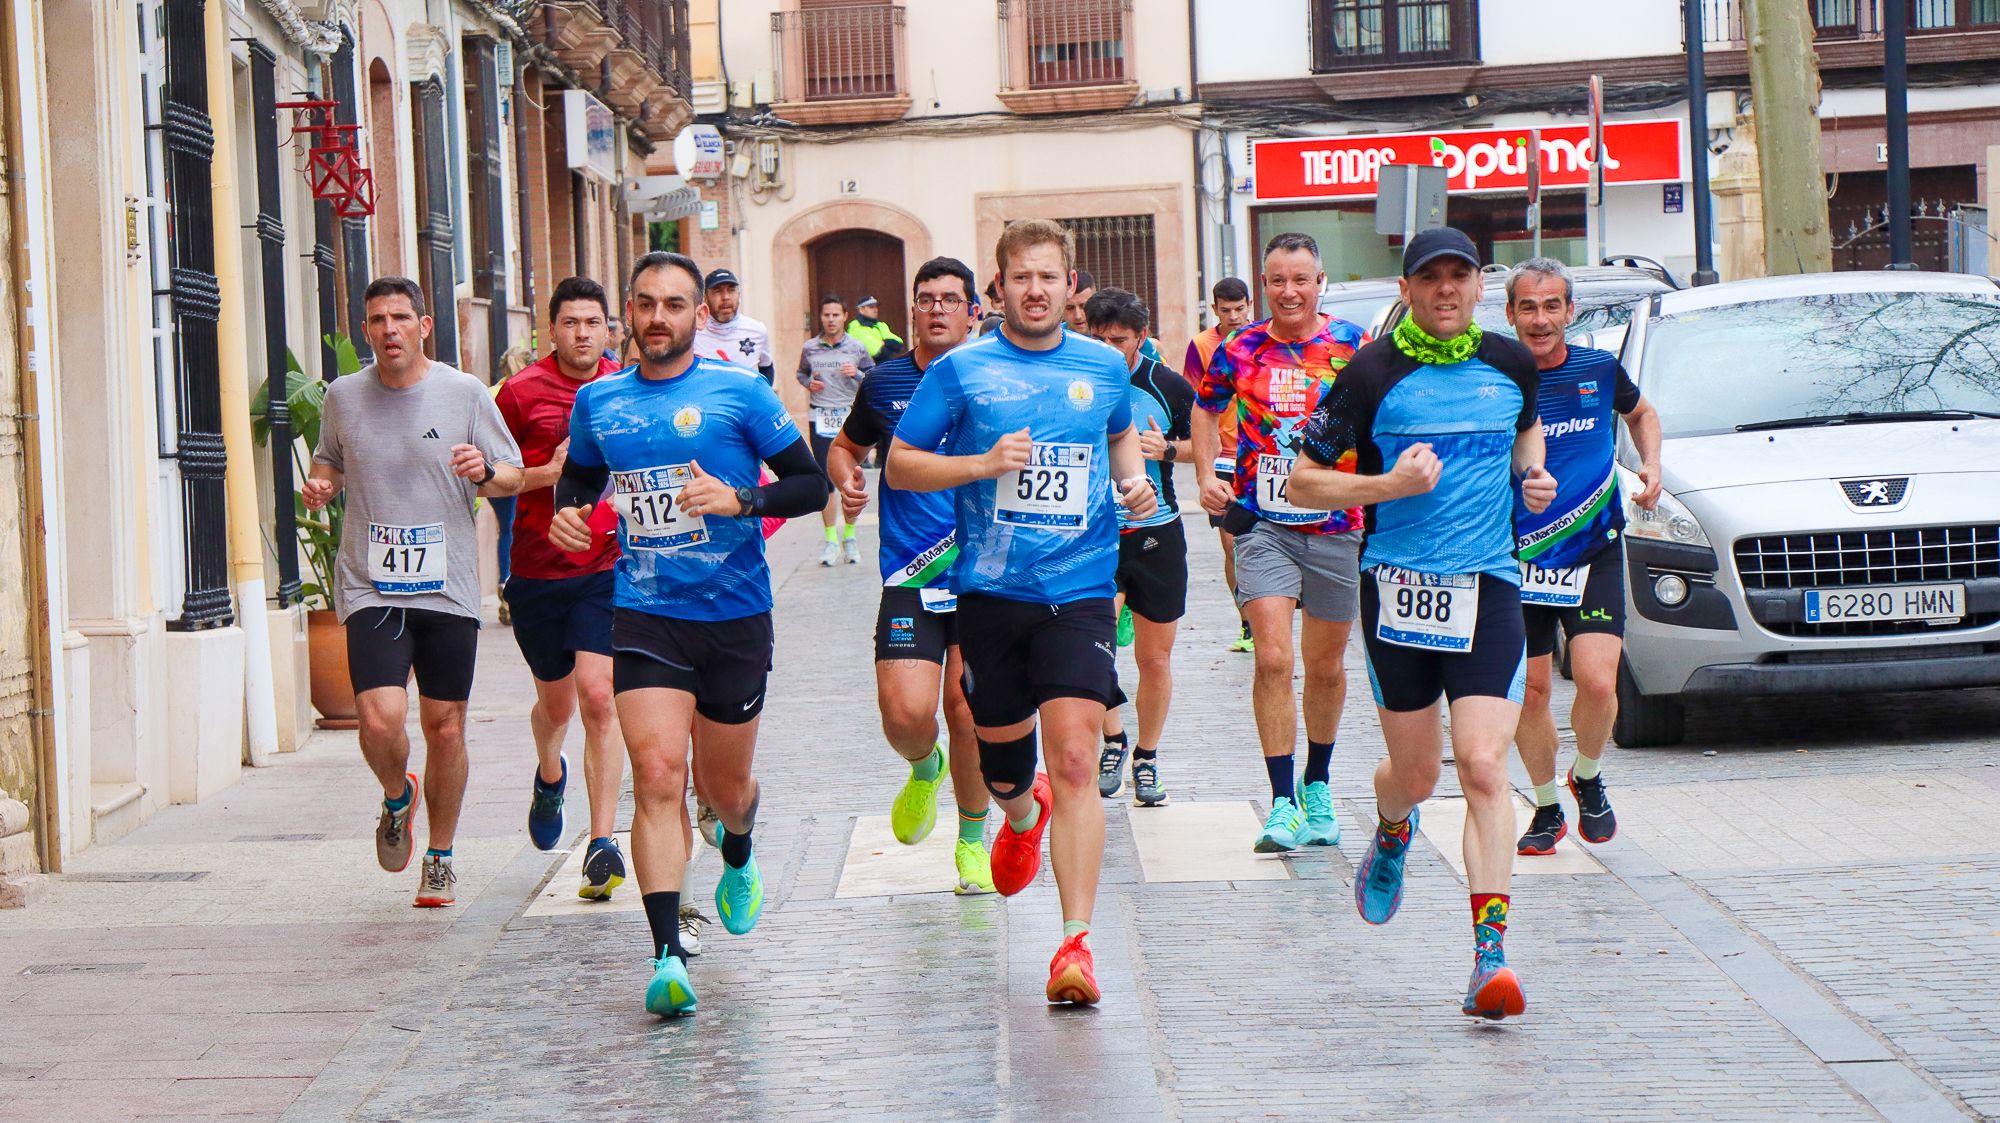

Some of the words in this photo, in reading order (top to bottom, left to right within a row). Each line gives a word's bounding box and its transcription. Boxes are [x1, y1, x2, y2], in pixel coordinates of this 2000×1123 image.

[1430, 136, 1619, 189] optima
[1542, 417, 1596, 438] erplus
[1017, 469, 1069, 502] 523
[1266, 472, 1289, 503] 14
[631, 493, 677, 526] 512
[1531, 513, 1573, 544] Maratón
[1570, 488, 1605, 520] Lucena
[378, 526, 402, 545] 21K
[382, 547, 427, 573] 417
[905, 555, 926, 577] Club
[1396, 587, 1453, 623] 988
[1810, 609, 1817, 617] E
[1827, 593, 1893, 618] 6280
[1905, 590, 1954, 615] HMN
